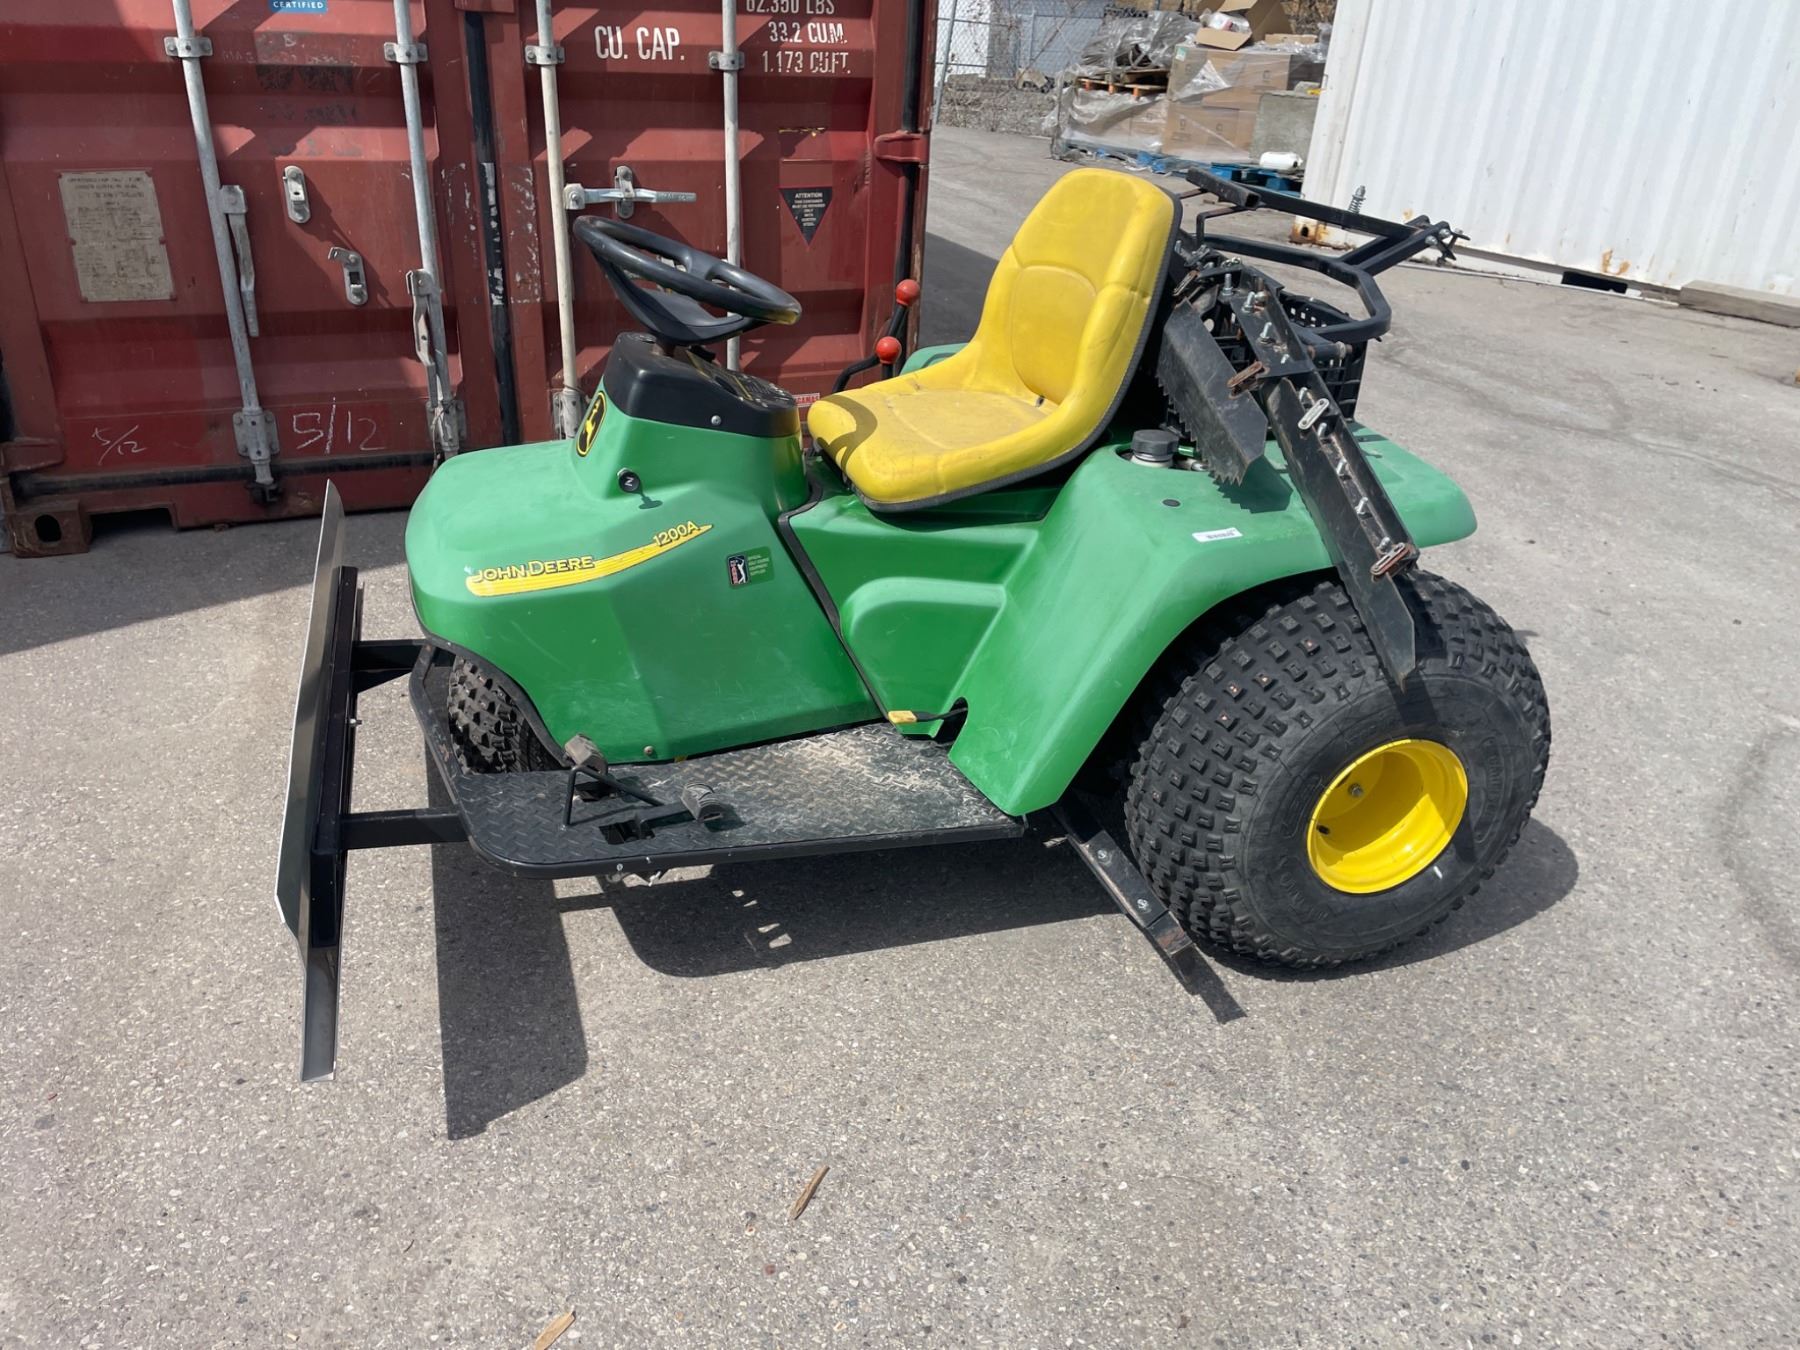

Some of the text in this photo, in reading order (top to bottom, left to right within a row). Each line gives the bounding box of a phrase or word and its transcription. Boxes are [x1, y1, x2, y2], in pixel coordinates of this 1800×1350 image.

[273, 1, 323, 9] CERTIFIED
[806, 0, 834, 14] LBS
[594, 25, 685, 60] CU. CAP.
[768, 21, 802, 43] 33.2
[762, 50, 803, 73] 1.173
[293, 397, 385, 454] 5/12
[653, 520, 700, 546] 1200A
[472, 555, 596, 584] JOHN DEERE
